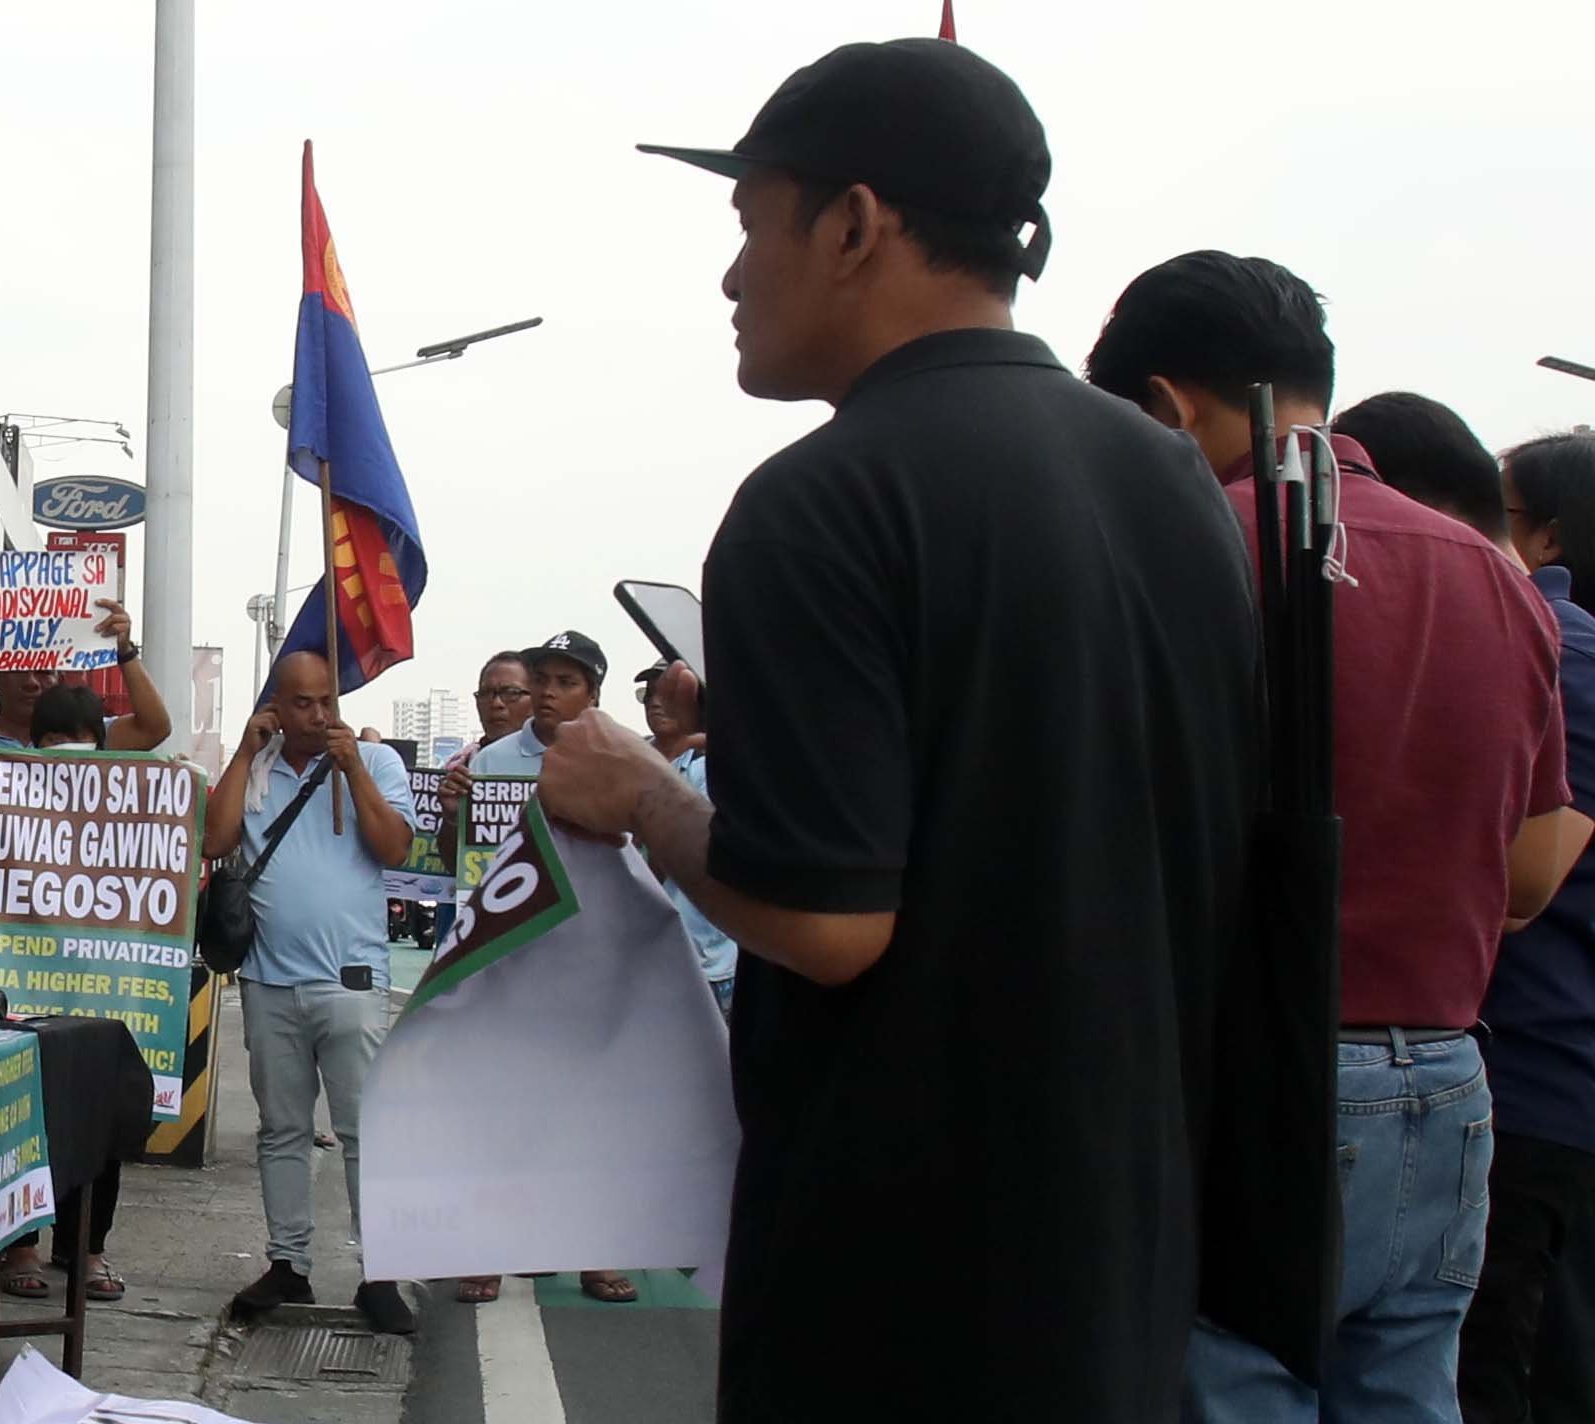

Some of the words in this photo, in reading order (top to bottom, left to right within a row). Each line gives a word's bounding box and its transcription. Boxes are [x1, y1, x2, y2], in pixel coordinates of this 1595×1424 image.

[41, 482, 132, 521] Ford
[82, 554, 107, 586] SA
[105, 763, 141, 816] SA
[145, 765, 193, 818] TAO
[471, 803, 521, 824] HUW
[78, 820, 189, 874] GAWING
[62, 936, 189, 970] PRIVATIZED
[25, 971, 112, 996] HIGHER
[116, 973, 176, 1008] FEES,
